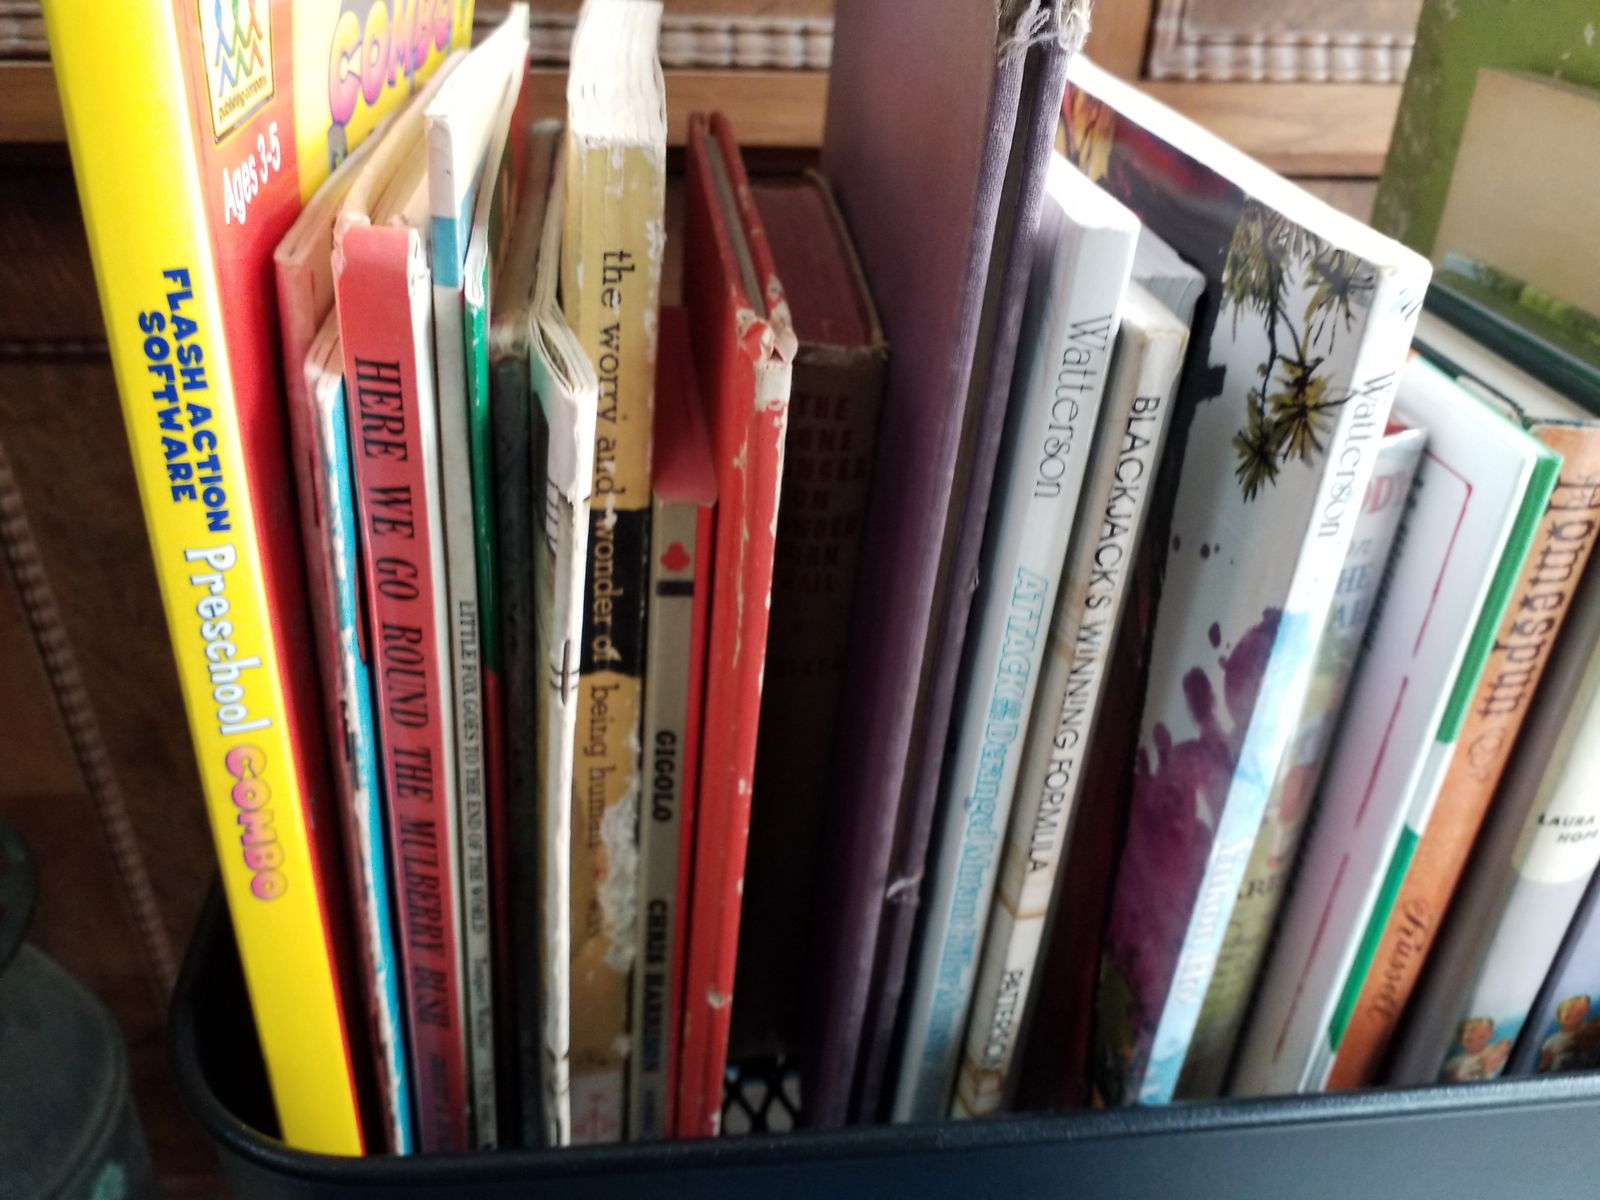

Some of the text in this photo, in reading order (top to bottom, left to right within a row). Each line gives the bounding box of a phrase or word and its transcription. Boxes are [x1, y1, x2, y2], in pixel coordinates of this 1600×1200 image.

[223, 121, 282, 225] Ages 3-5
[138, 310, 199, 504] SOFTWARE
[162, 267, 232, 534] FLASH ACTION
[354, 356, 409, 462] HERE
[593, 250, 635, 497] the worry and
[1033, 313, 1114, 500] Watterson
[369, 484, 416, 540] WE
[1085, 396, 1162, 611] BLACKJACK'S
[1317, 370, 1398, 538] Watterson
[375, 555, 421, 602] GO
[593, 513, 625, 626] wonder
[1479, 472, 1600, 719] Homespun
[183, 543, 273, 737] Preschool
[381, 622, 430, 729] ROUND
[459, 600, 477, 660] LITTLE
[462, 663, 479, 696] FOX
[996, 565, 1049, 699] ATTACK
[1055, 620, 1108, 751] WINNING
[393, 745, 435, 804] THE
[463, 699, 480, 743] GOES
[465, 745, 481, 766] TO
[582, 684, 620, 849] being human
[652, 728, 677, 824] GIGOLO
[224, 743, 290, 903] COMBO
[465, 768, 482, 798] THE
[1029, 757, 1074, 874] FORMULA
[401, 812, 448, 956] MULBERRY
